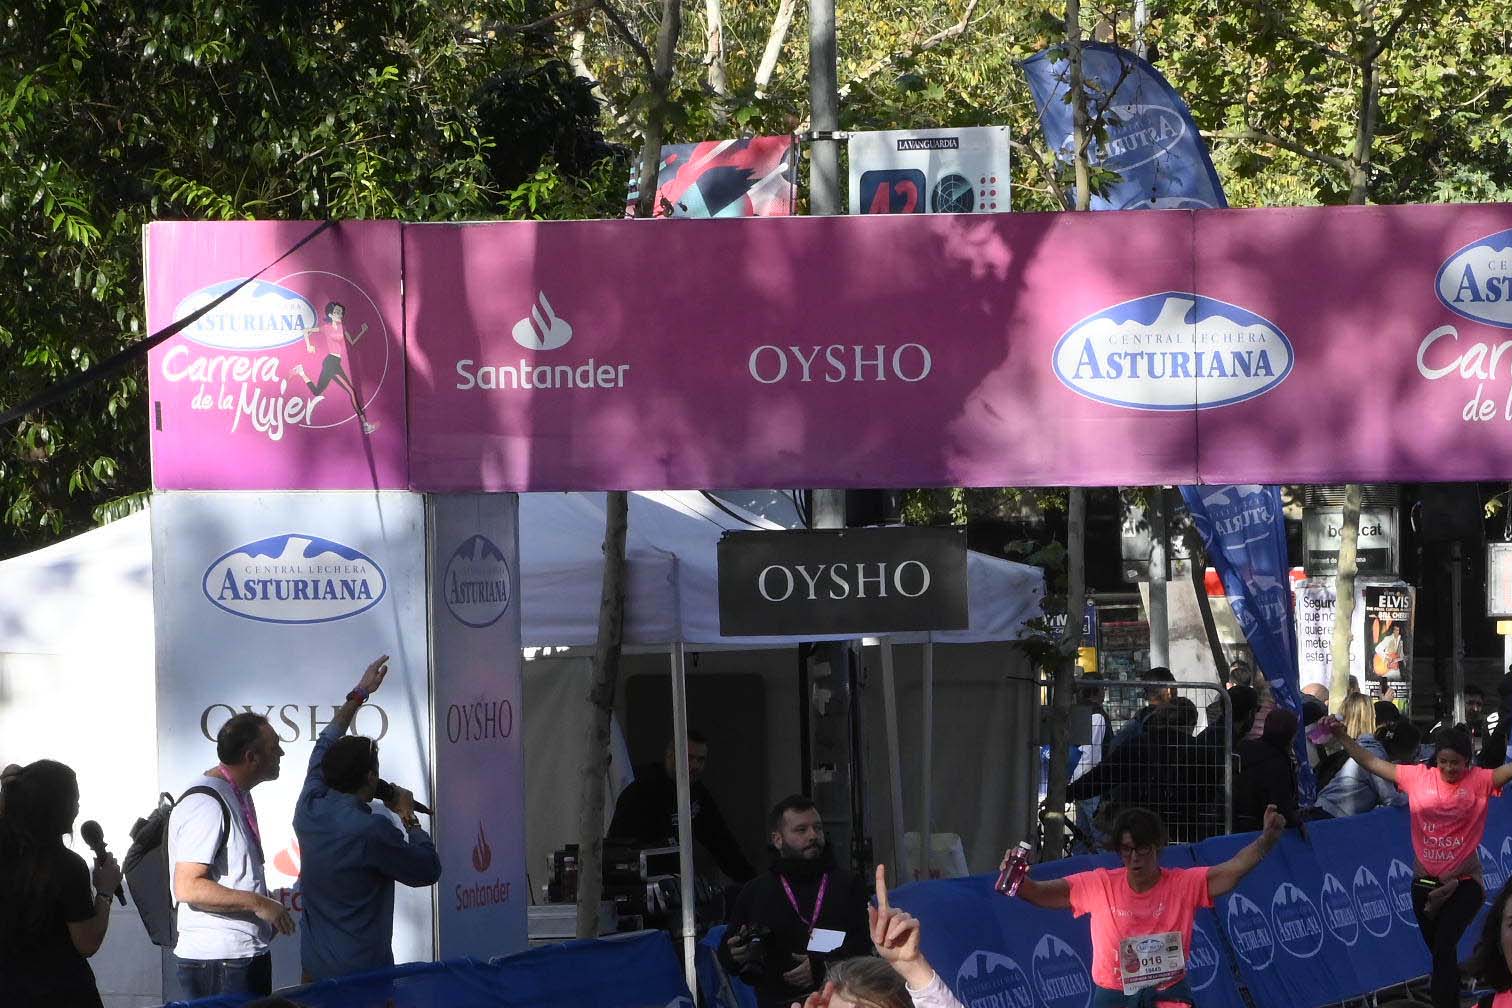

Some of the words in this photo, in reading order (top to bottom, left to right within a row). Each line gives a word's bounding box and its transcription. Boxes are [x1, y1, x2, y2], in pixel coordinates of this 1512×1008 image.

[1108, 333, 1184, 345] CENTRAL
[1191, 331, 1268, 344] LECHERA
[162, 345, 280, 382] Carrera
[456, 358, 630, 390] Santander
[748, 343, 932, 384] OYSHO
[1072, 336, 1275, 380] ASTURIANA
[191, 384, 213, 410] de
[218, 384, 234, 410] la
[231, 378, 325, 441] Mujer
[1462, 385, 1496, 422] de
[217, 568, 373, 601] ASTURIANA
[245, 565, 302, 574] CENTRAL
[309, 565, 367, 574] LECHERA
[450, 567, 507, 606] ASTURIANA
[757, 560, 931, 602] OYSHO
[1379, 596, 1409, 608] ELVIS
[446, 699, 513, 744] OYSHO
[1424, 850, 1455, 860] SUMA
[455, 881, 512, 912] Santander
[1142, 956, 1162, 966] 016
